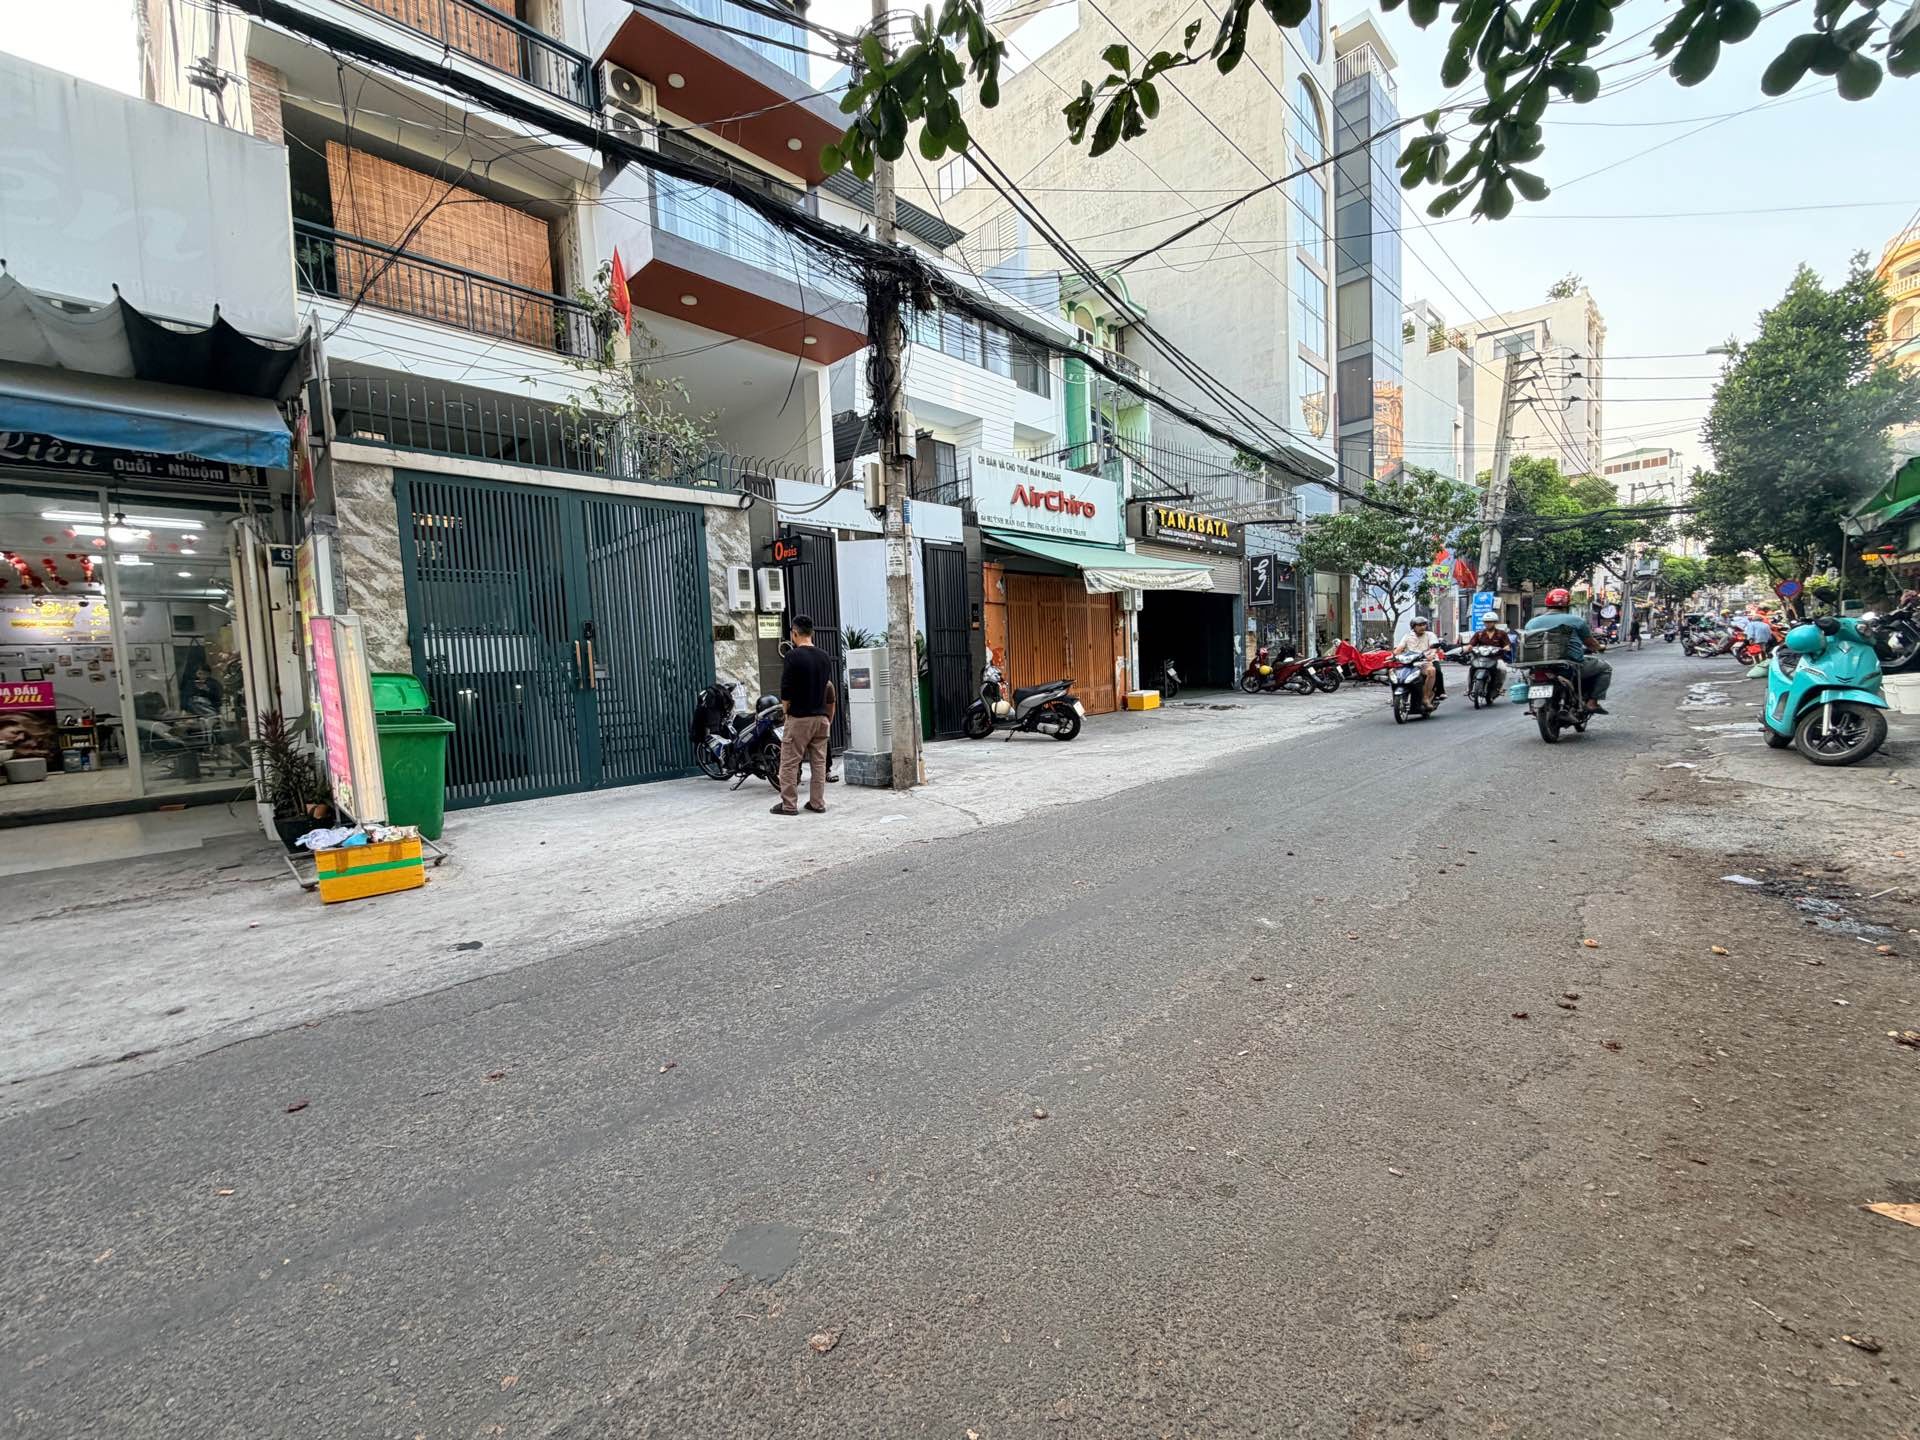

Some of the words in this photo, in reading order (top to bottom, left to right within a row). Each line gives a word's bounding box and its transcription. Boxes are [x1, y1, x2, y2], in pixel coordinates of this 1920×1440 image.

[168, 463, 224, 481] Nhuộm
[1010, 484, 1096, 518] AirChiro
[1158, 508, 1229, 538] TANABATA
[775, 541, 798, 561] Oasis
